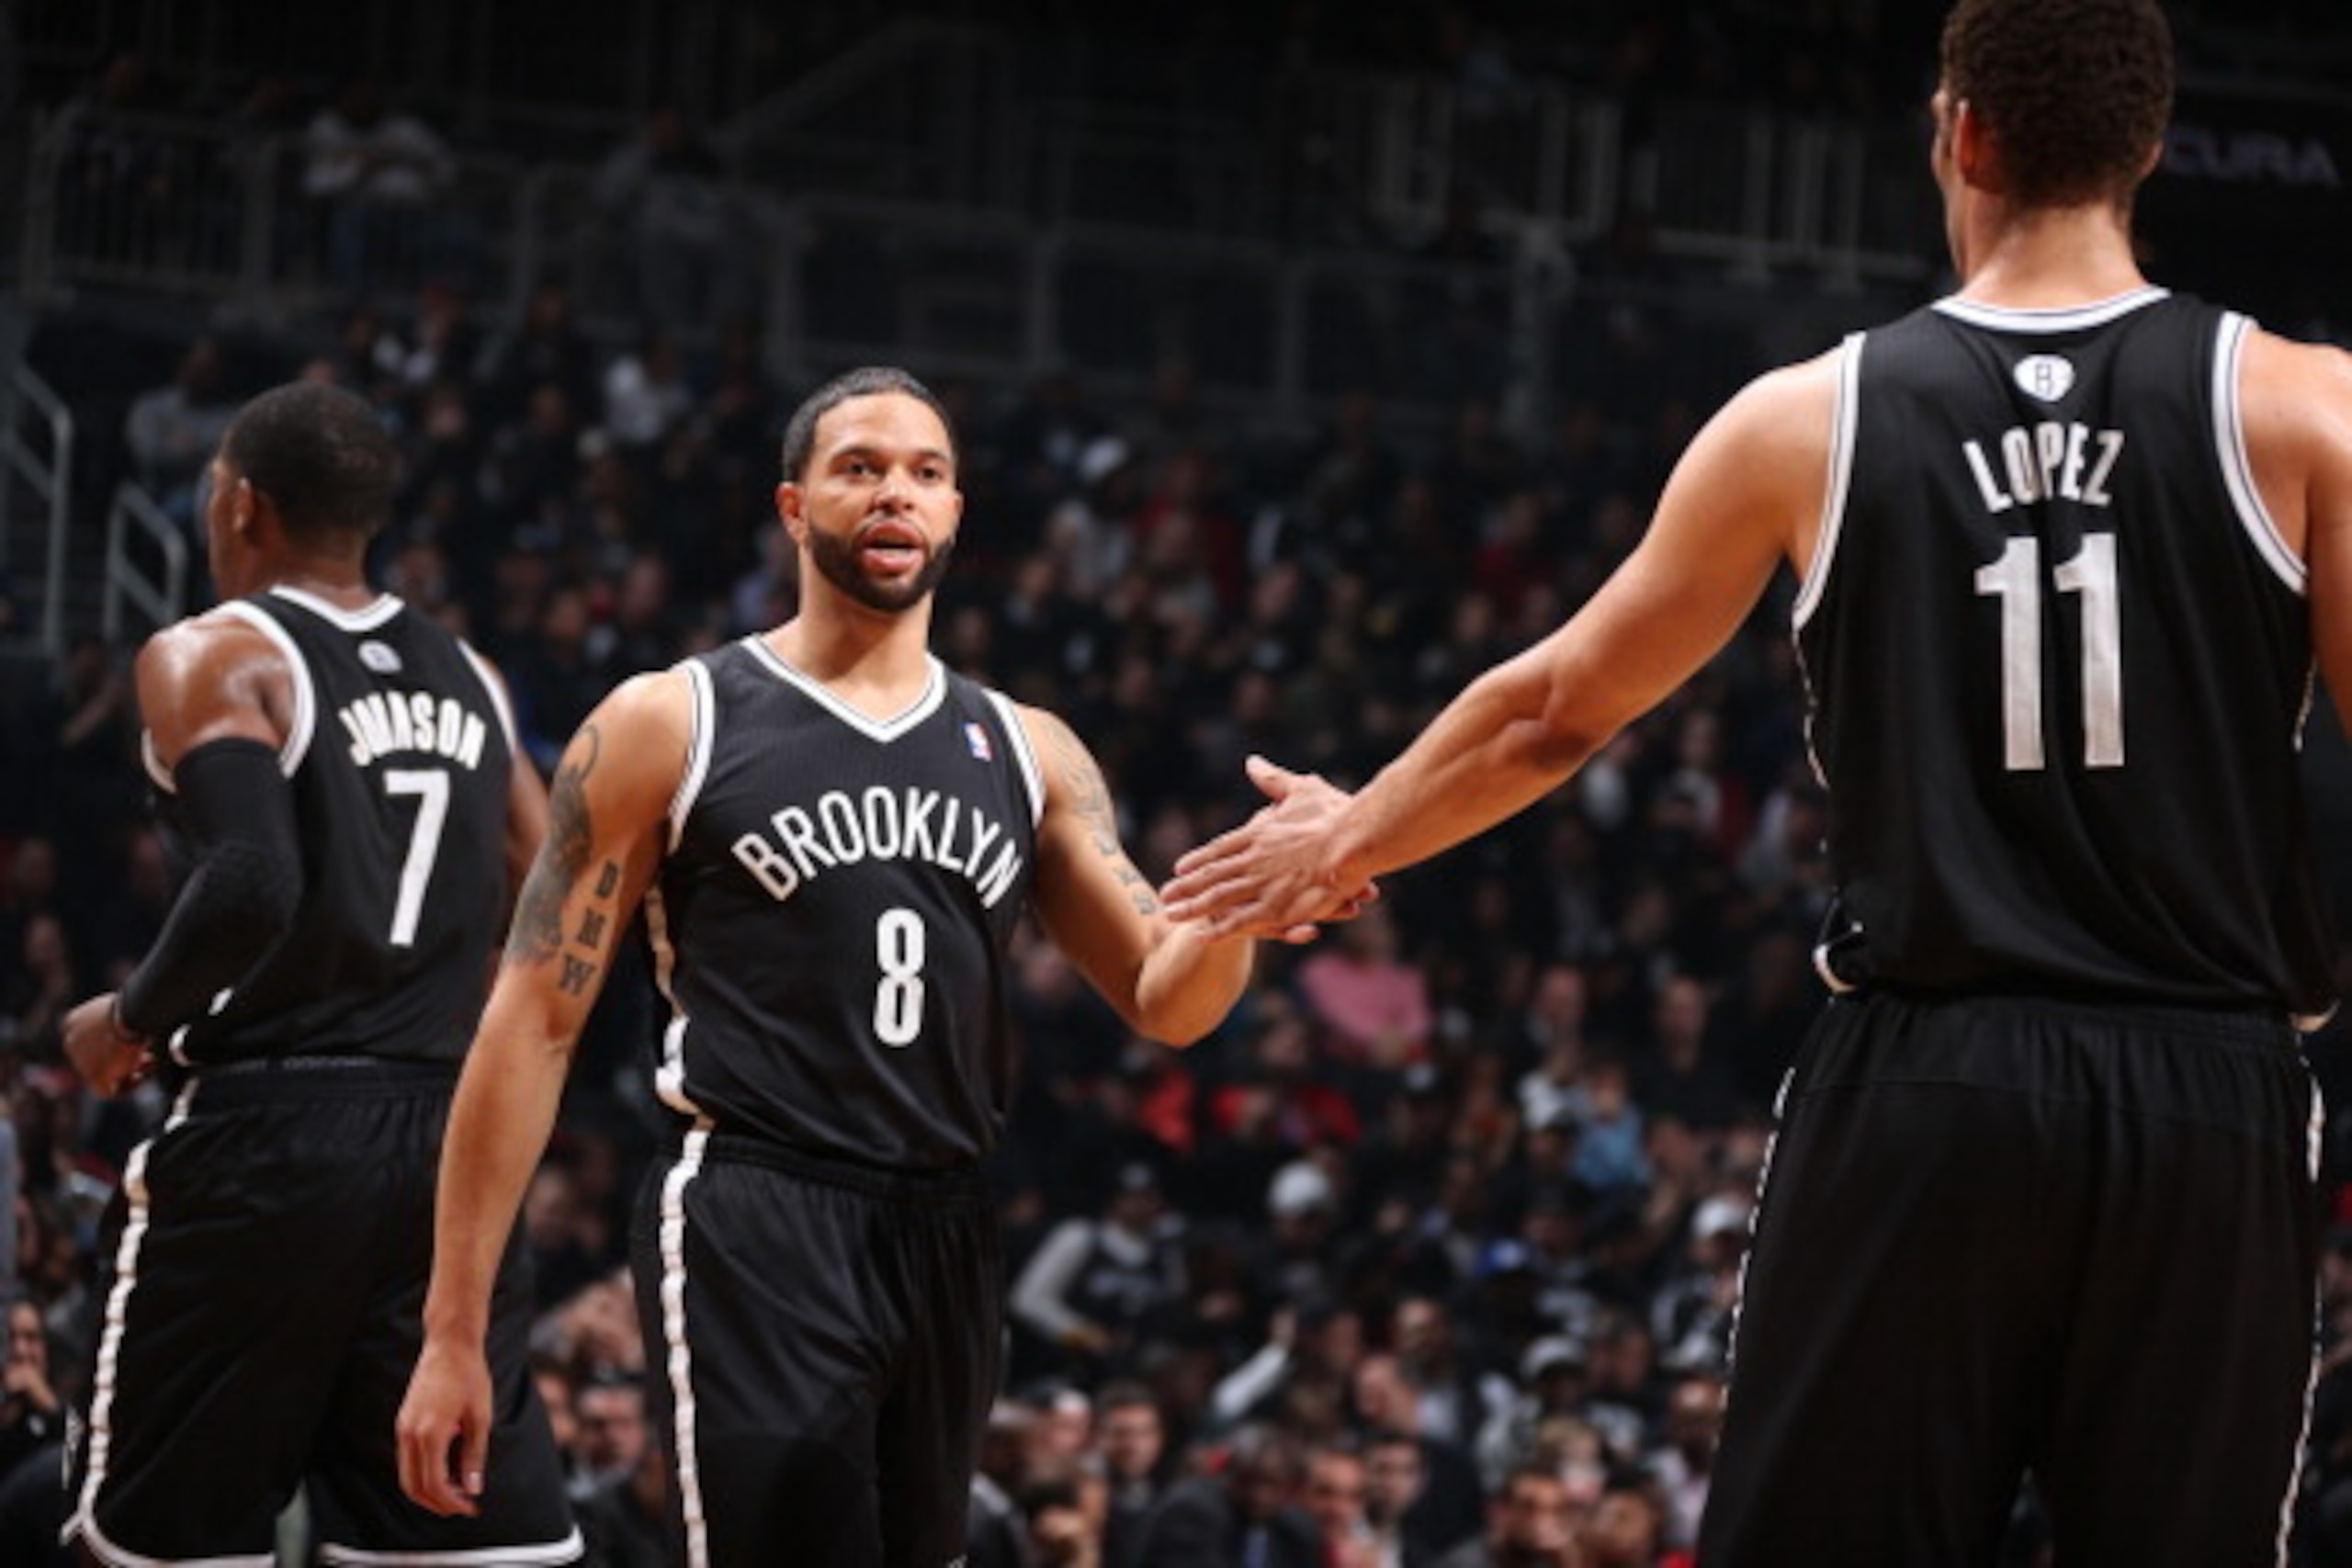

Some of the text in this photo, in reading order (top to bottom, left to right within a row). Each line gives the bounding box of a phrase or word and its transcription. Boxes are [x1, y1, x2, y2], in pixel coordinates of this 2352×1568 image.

[2163, 126, 2344, 187] CURA
[1962, 421, 2125, 513] LOPEZ
[1973, 532, 2125, 771] 11
[382, 770, 450, 947] 7
[731, 785, 1023, 909] BROOKLYN
[873, 907, 925, 1047] 8
